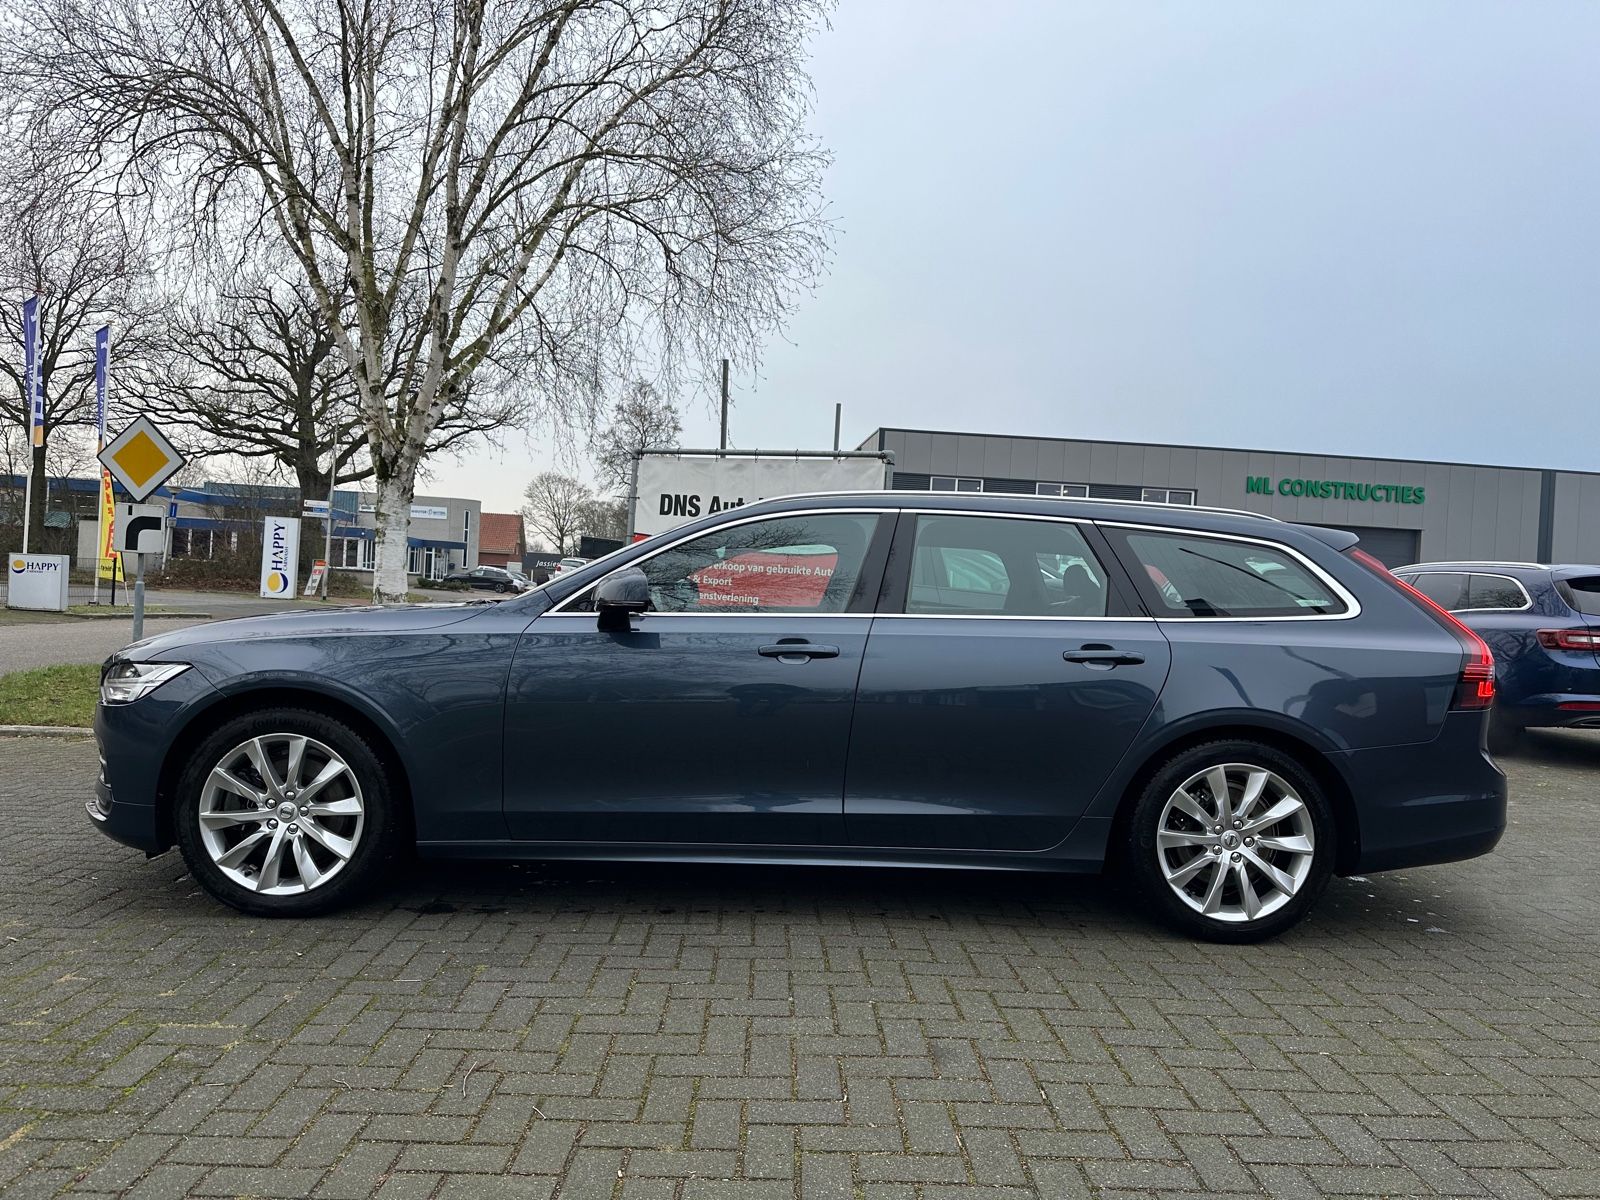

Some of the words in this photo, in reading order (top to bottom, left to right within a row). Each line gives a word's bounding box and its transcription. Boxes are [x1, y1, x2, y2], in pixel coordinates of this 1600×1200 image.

[1246, 476, 1275, 495] ML
[1279, 478, 1425, 504] CONSTRUCTIES
[659, 494, 701, 517] DNS
[271, 522, 285, 571] HAPPY
[27, 561, 59, 571] HAPPY
[766, 565, 812, 575] gebruikte
[692, 575, 701, 583] &
[703, 575, 732, 586] Export
